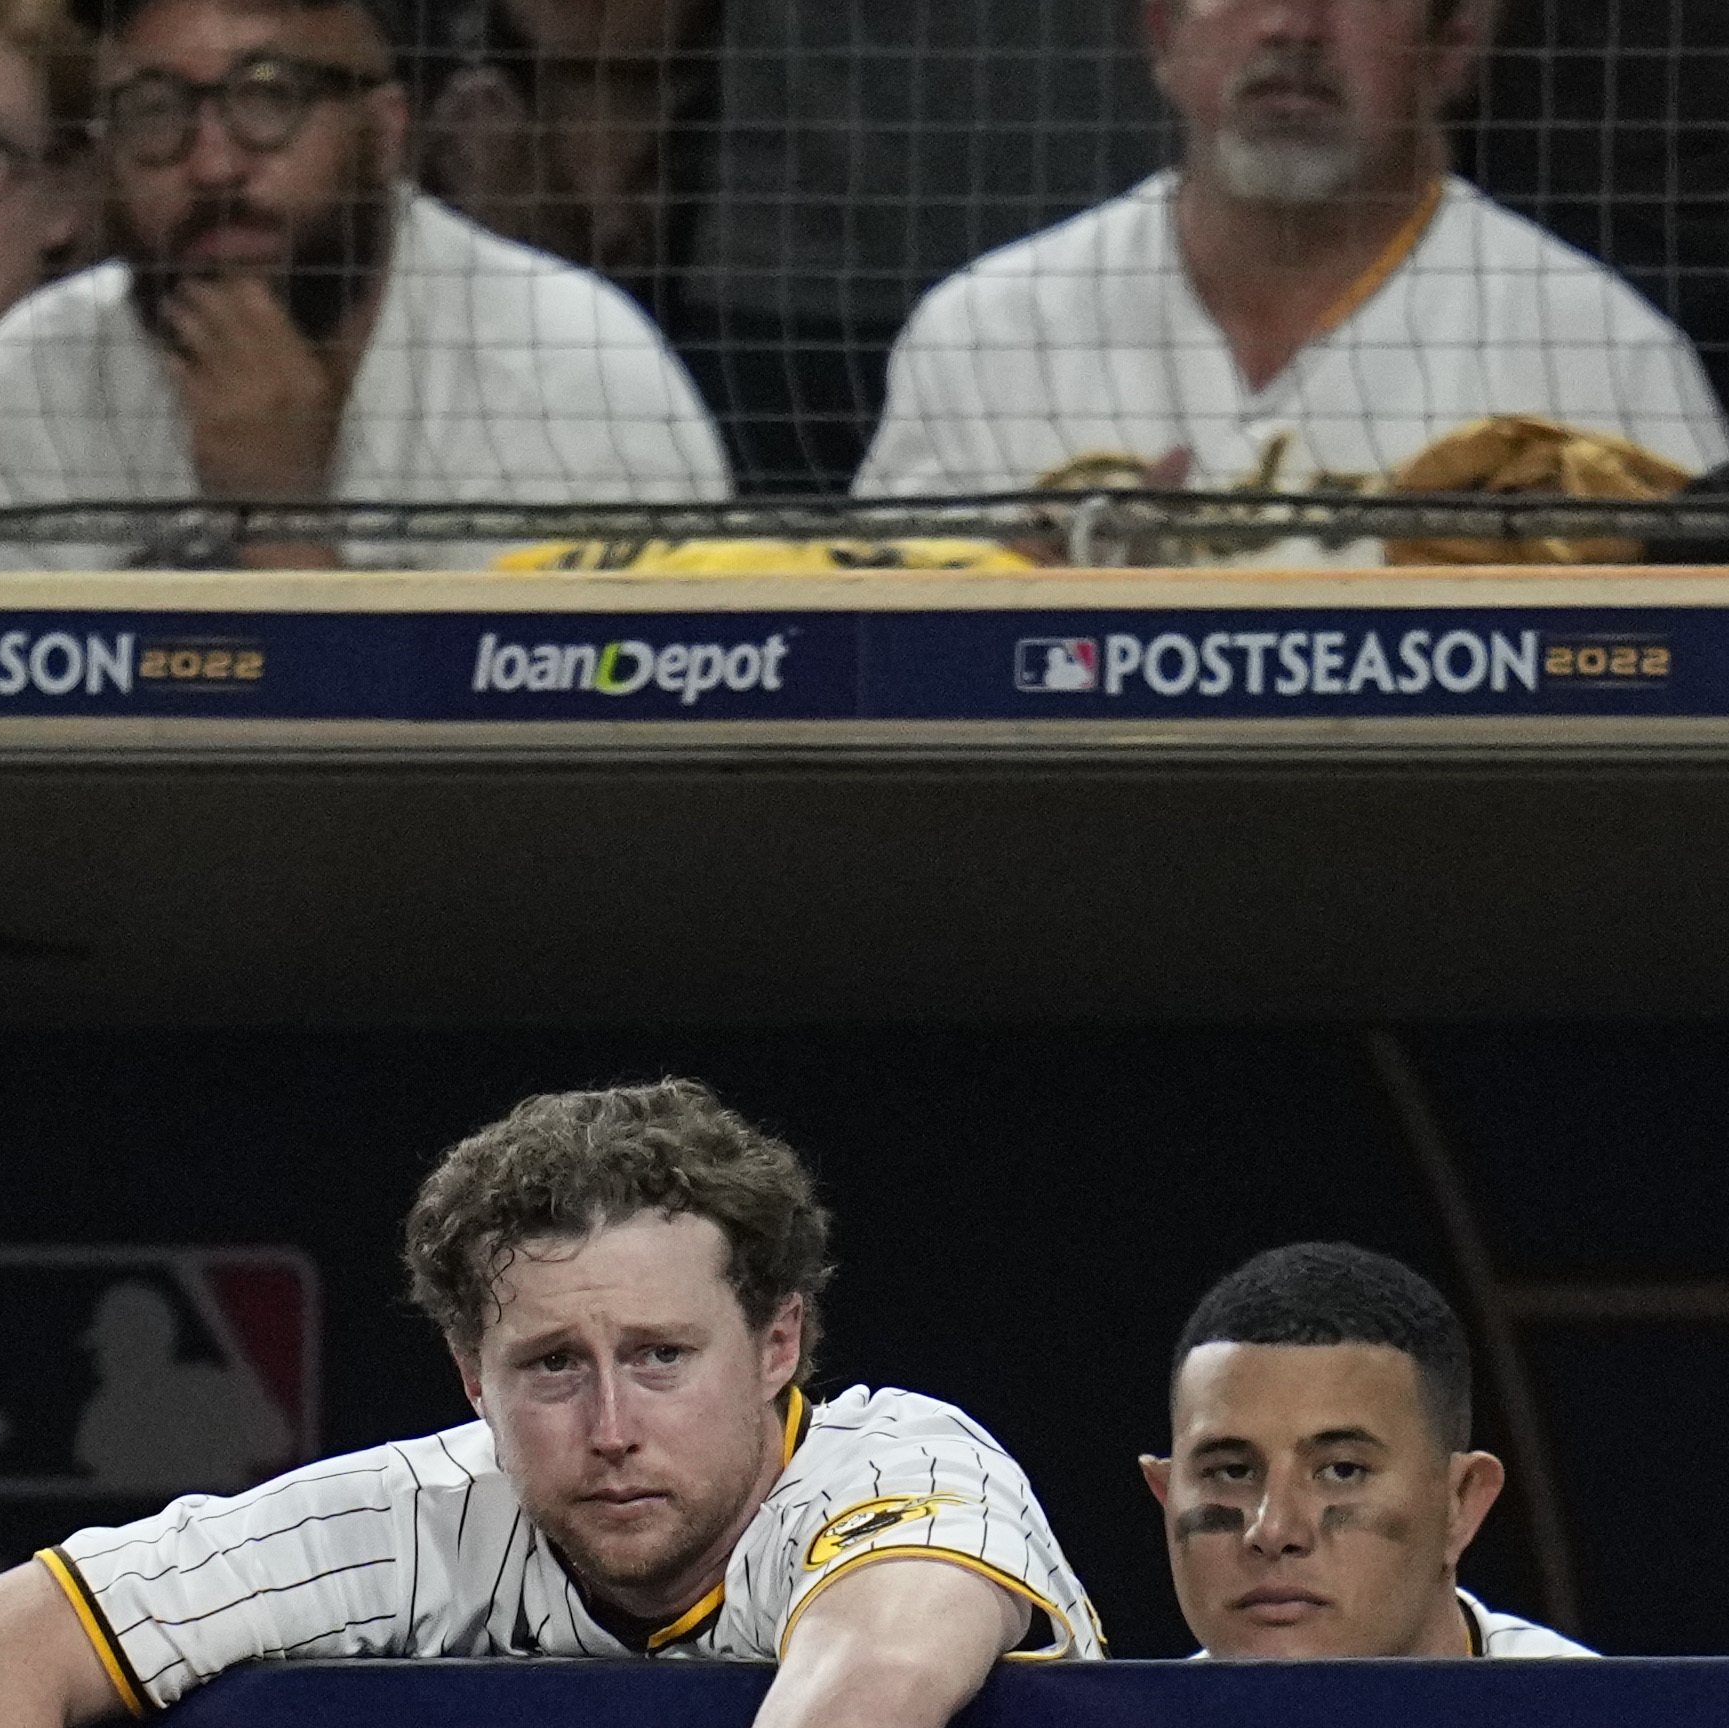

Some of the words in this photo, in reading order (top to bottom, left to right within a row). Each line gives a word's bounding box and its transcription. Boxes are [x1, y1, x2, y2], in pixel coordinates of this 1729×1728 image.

[139, 650, 264, 679] 2022
[472, 632, 785, 706] loanDepot
[1104, 628, 1540, 696] POSTSEASON
[1545, 646, 1671, 677] 2022
